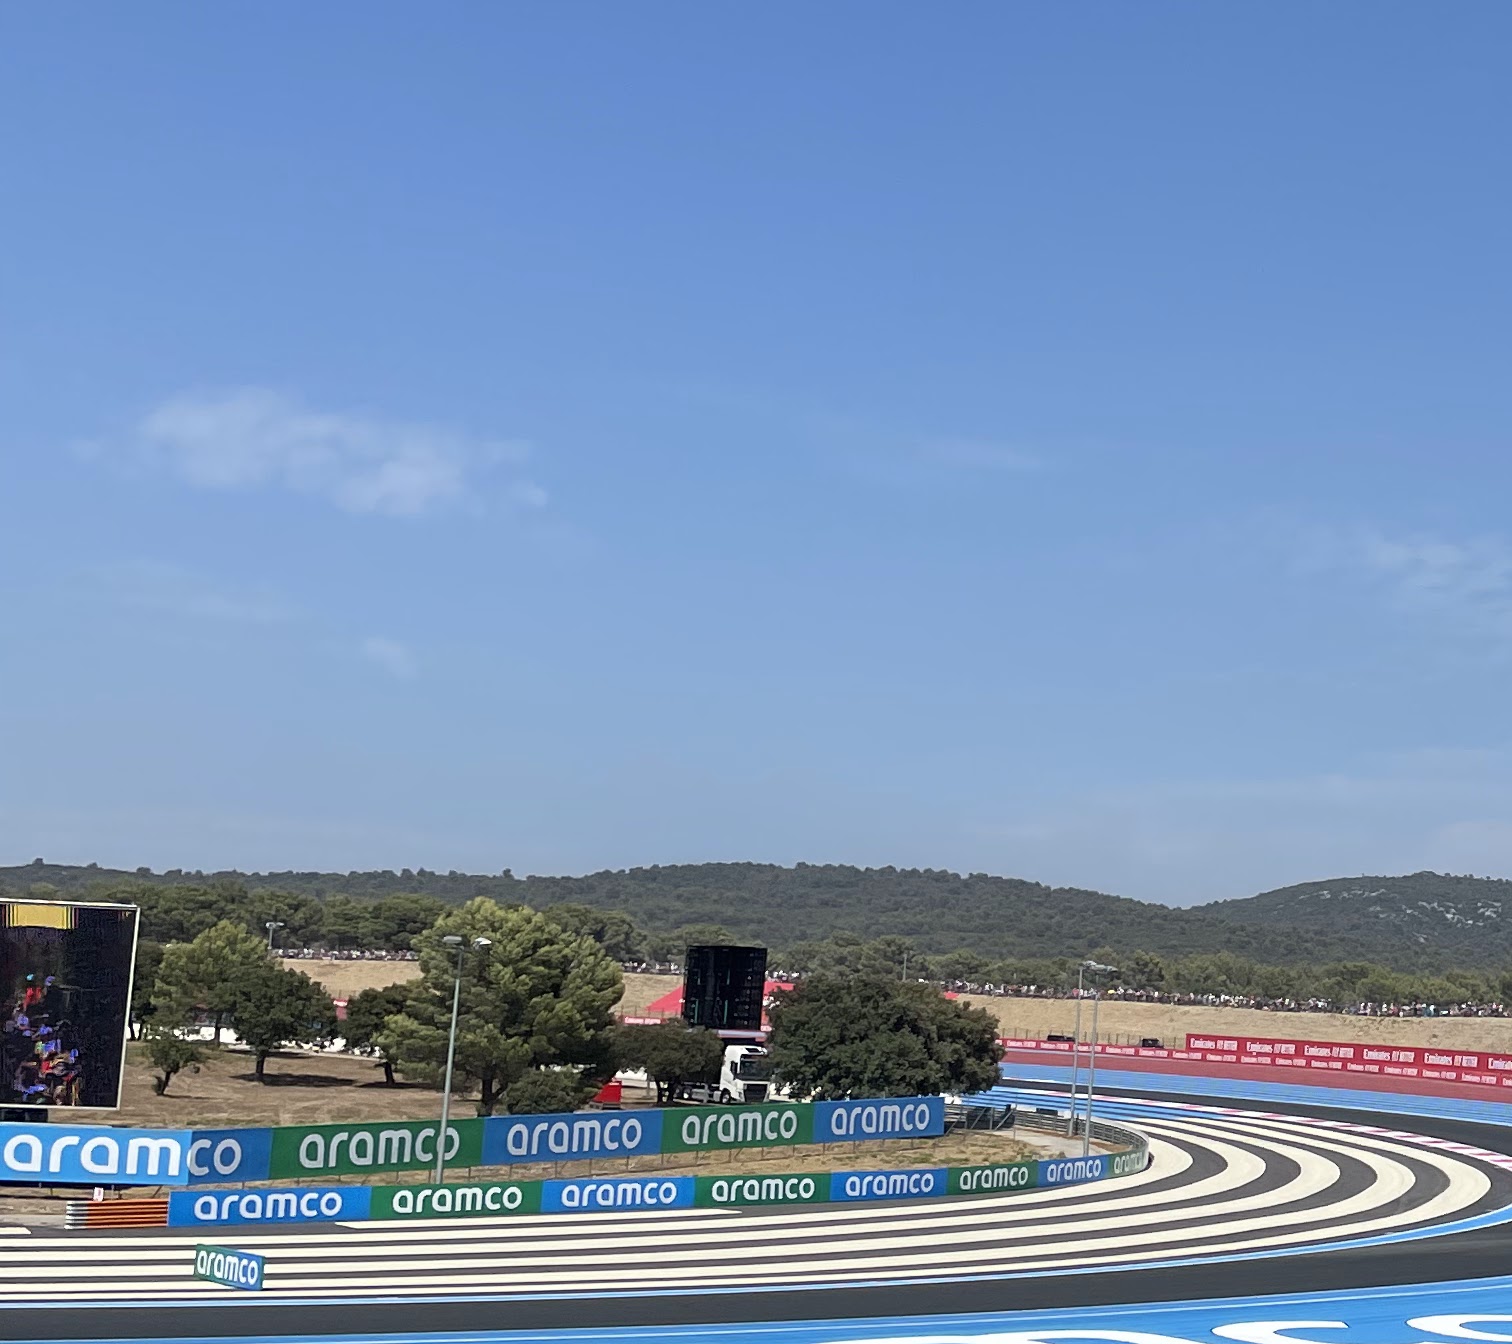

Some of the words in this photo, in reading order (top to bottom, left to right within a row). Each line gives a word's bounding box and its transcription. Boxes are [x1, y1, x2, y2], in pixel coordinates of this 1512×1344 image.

[682, 1107, 797, 1144] aramco
[832, 1104, 929, 1135] aramco
[300, 1128, 459, 1168] aramco
[507, 1119, 641, 1155] aramco
[4, 1135, 241, 1175] aramco
[960, 1167, 1028, 1189] aramco
[1048, 1160, 1101, 1181] aramco
[562, 1182, 676, 1206] aramco
[712, 1178, 814, 1201] aramco
[846, 1174, 933, 1196] aramco
[195, 1192, 342, 1220] aramco
[393, 1187, 522, 1213] aramco
[197, 1250, 258, 1286] aramco
